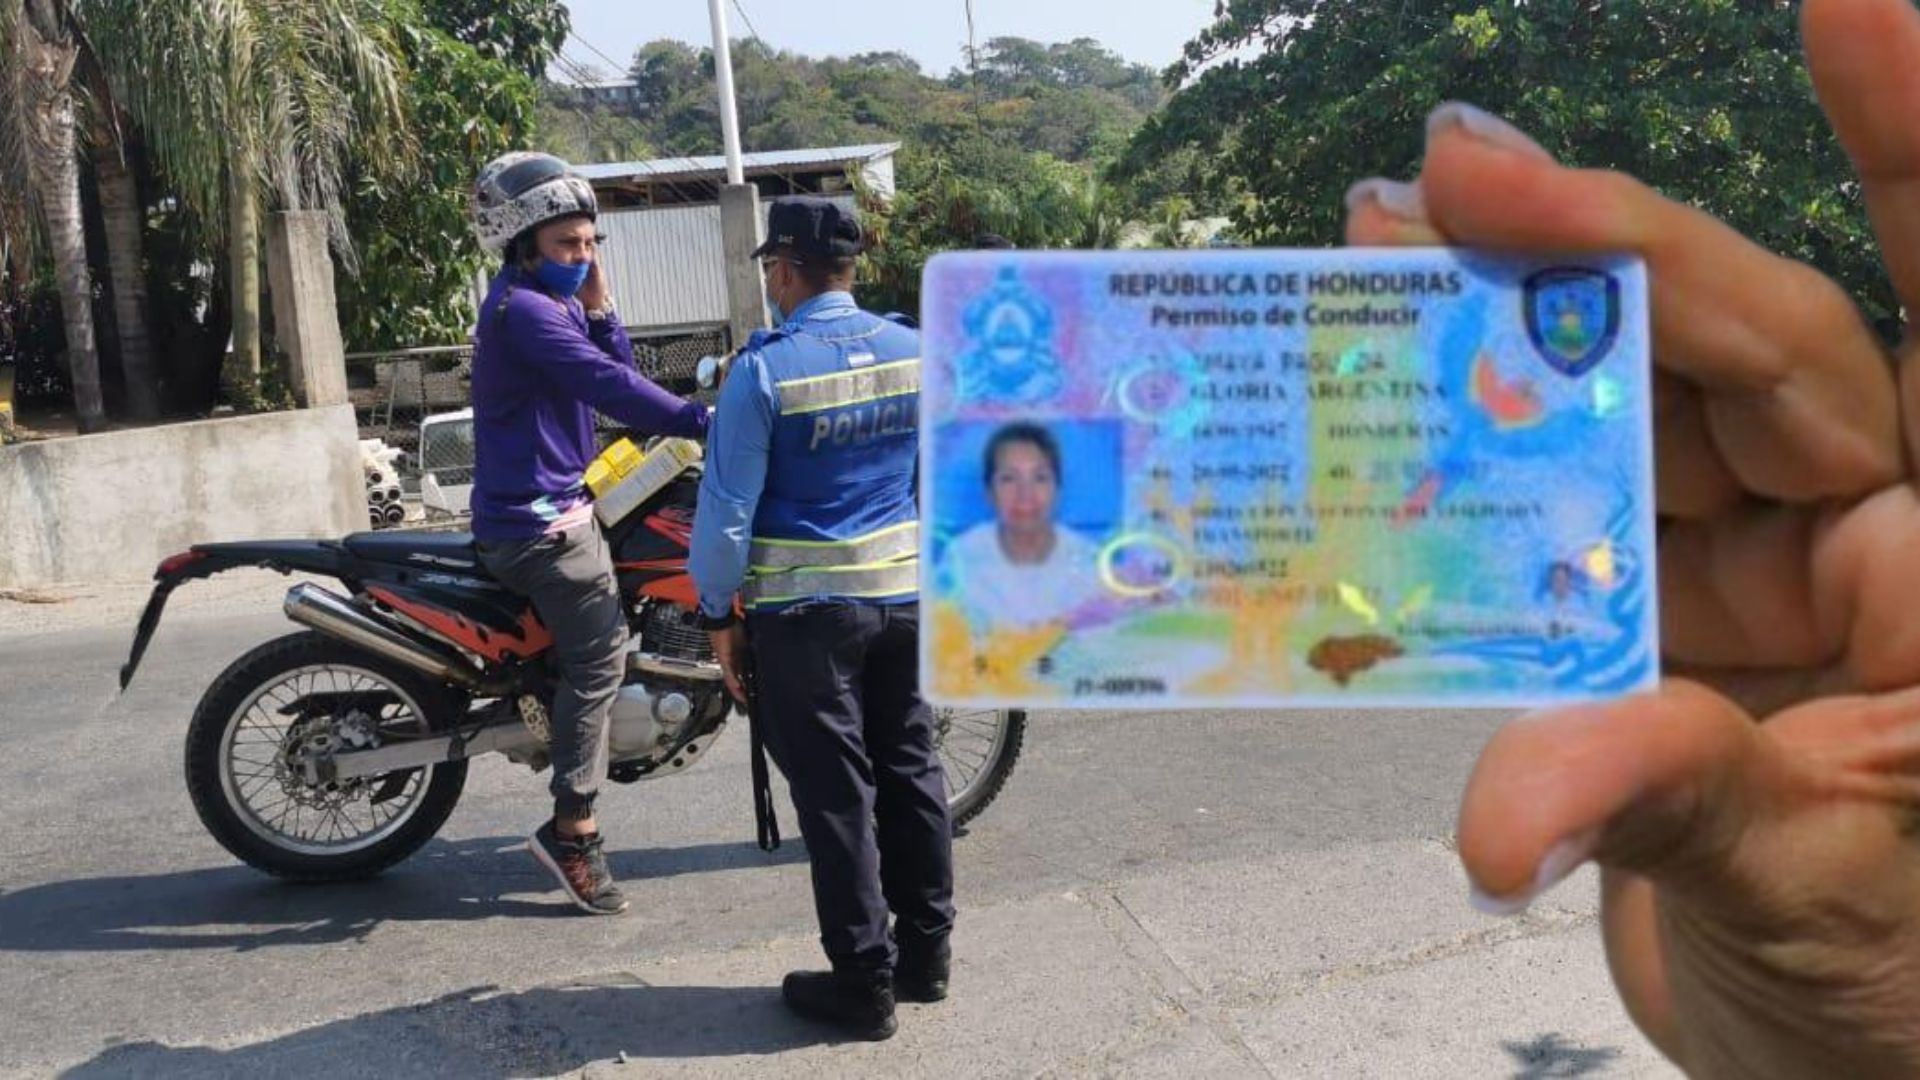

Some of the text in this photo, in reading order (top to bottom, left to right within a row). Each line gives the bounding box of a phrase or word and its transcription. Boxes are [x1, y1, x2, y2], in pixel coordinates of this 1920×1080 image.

[1109, 270, 1462, 297] REPÚBLICA DE HONDURAS
[1150, 304, 1422, 327] Permiso de Conducir
